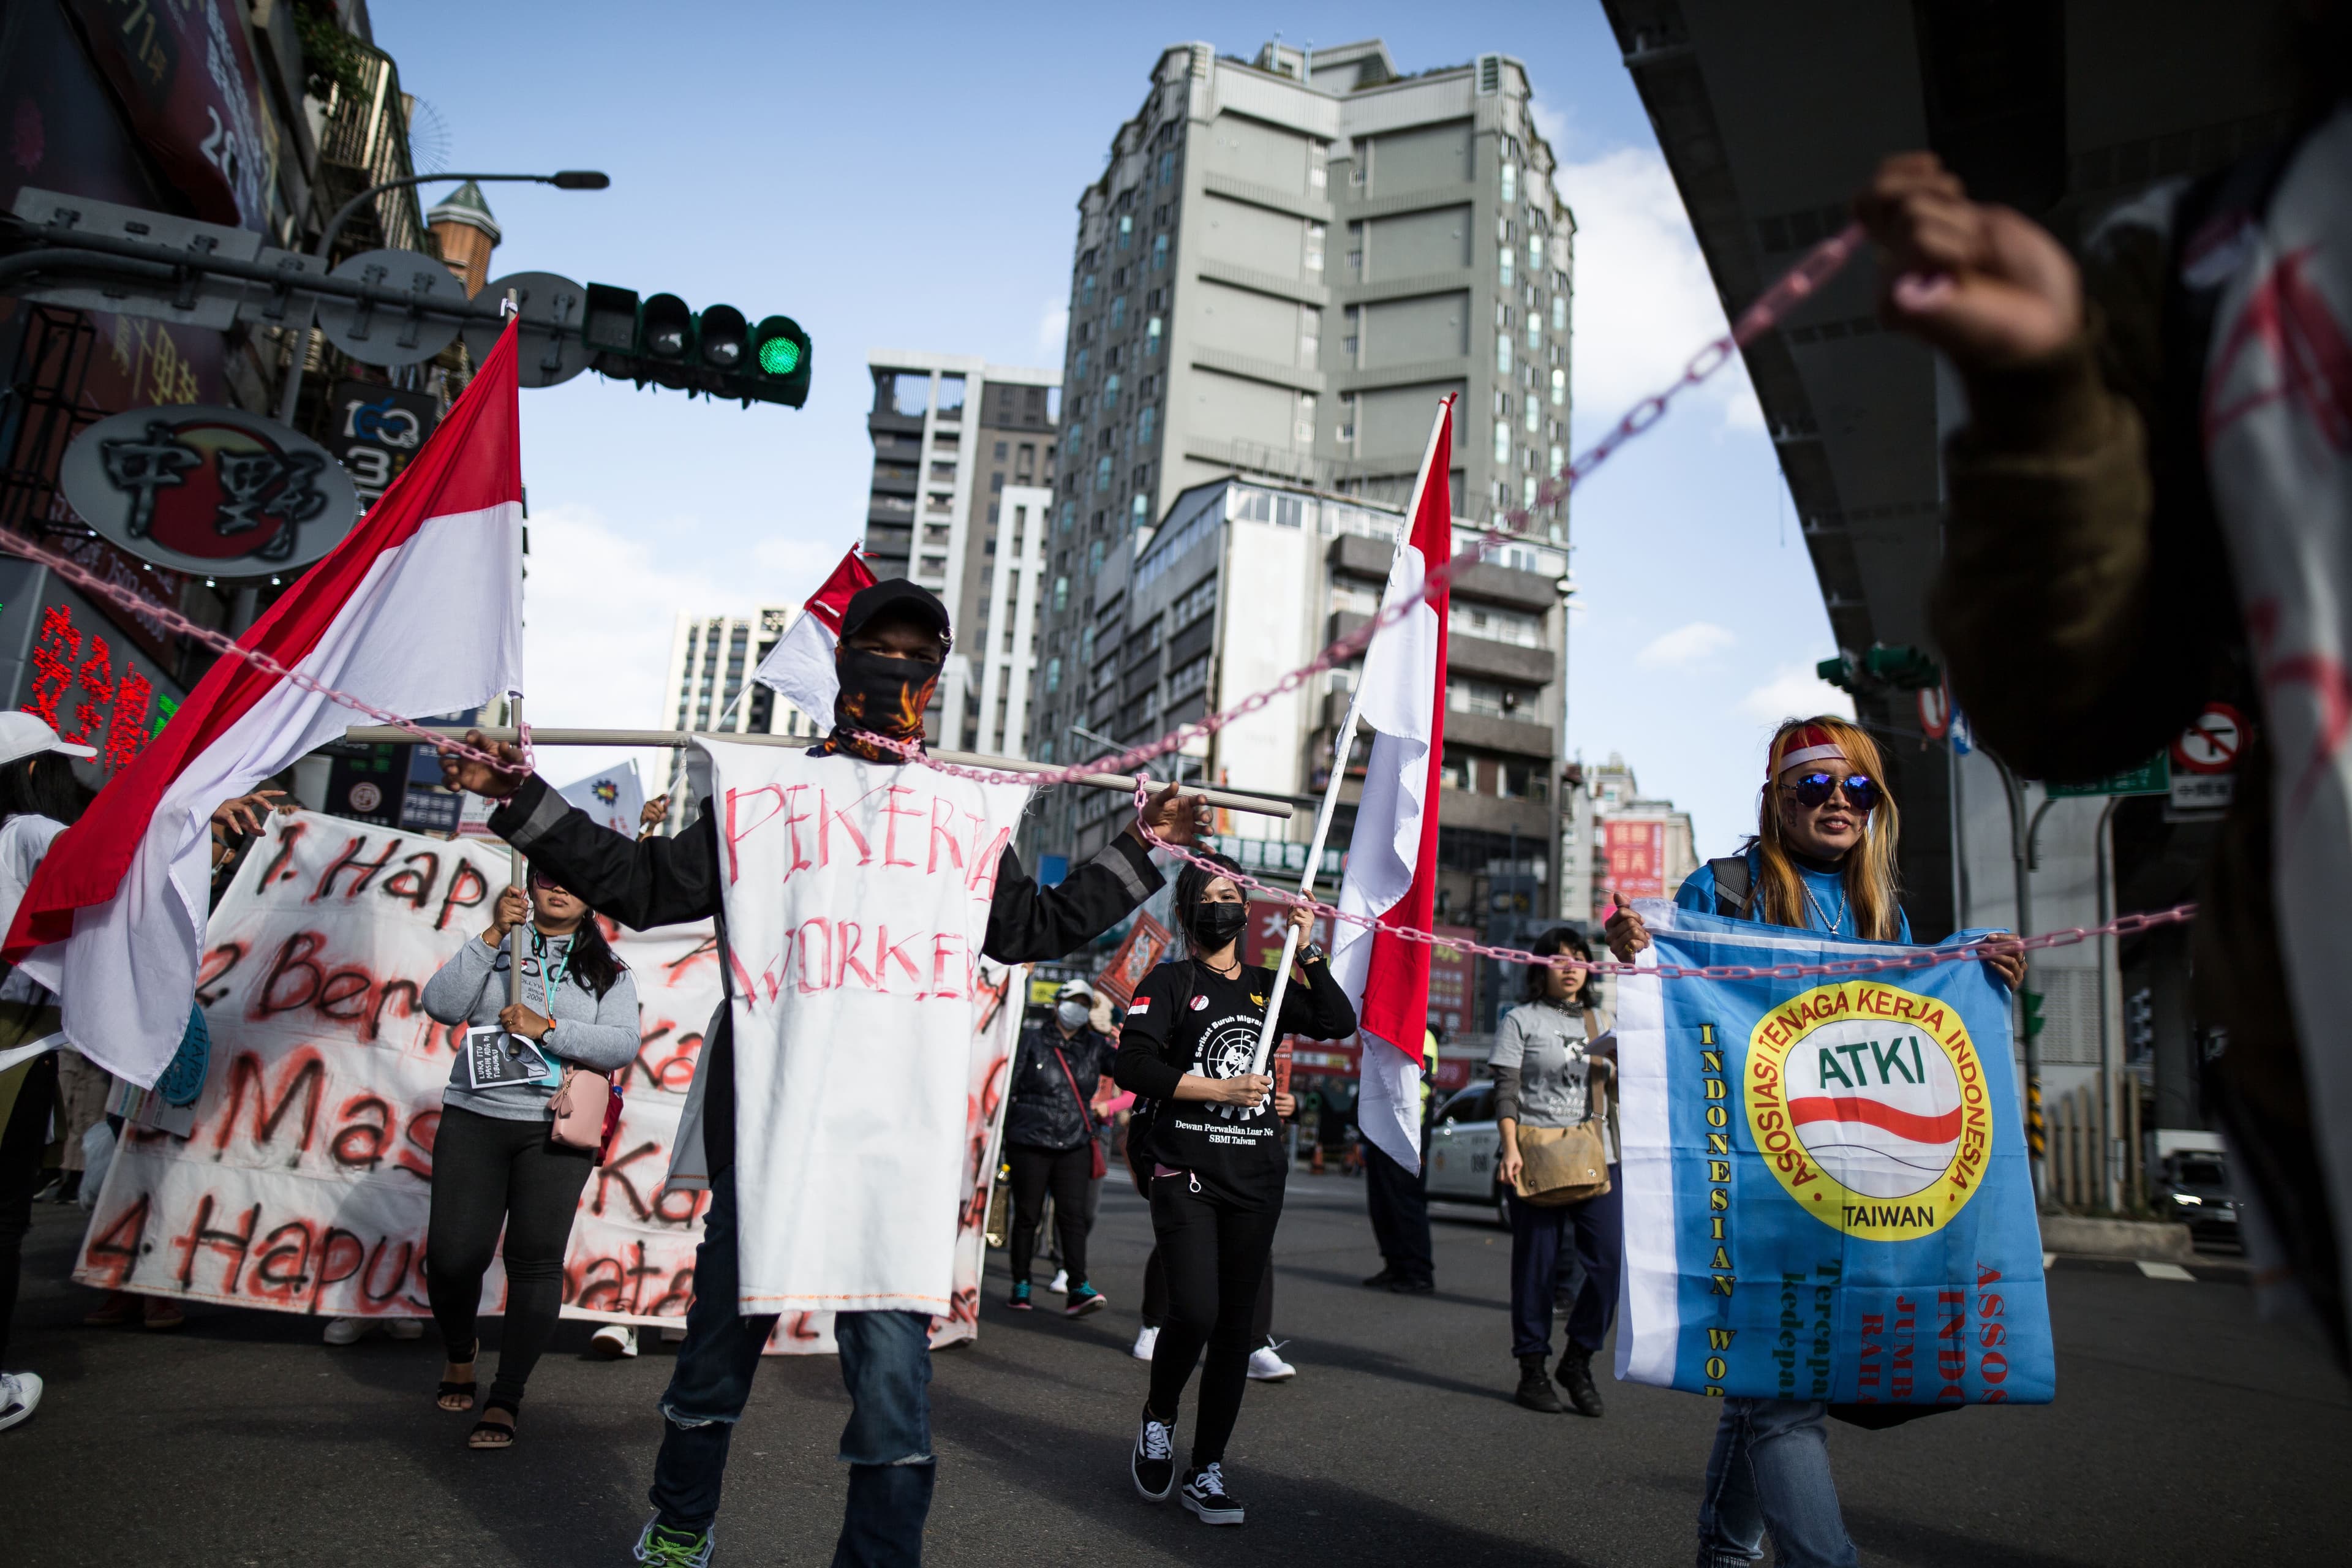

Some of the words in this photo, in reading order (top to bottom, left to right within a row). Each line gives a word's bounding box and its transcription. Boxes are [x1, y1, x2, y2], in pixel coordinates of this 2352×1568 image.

[100, 420, 329, 562] 中野
[526, 992, 543, 1003] 2009
[1856, 988, 1945, 1033] KERJA
[1195, 1027, 1213, 1058] Serikat
[1211, 1015, 1235, 1030] Buruh
[1757, 991, 1849, 1054] TENAGA
[477, 1060, 485, 1079] LUKA
[491, 1049, 500, 1078] TUBUHKU
[1819, 1035, 1926, 1090] ATKI
[1175, 1120, 1203, 1131] Dewan
[1204, 1123, 1246, 1135] Perwakilan
[1246, 1127, 1263, 1136] Luar
[1753, 1053, 1819, 1188] ASOSIASI
[1945, 1029, 1986, 1191] INDONESIA
[1209, 1134, 1231, 1144] SBMI
[1231, 1136, 1256, 1145] Taiwan
[1699, 1023, 1735, 1298] INDONESIAN
[1842, 1205, 1934, 1227] TAIWAN
[1890, 1295, 1916, 1403] JUMB
